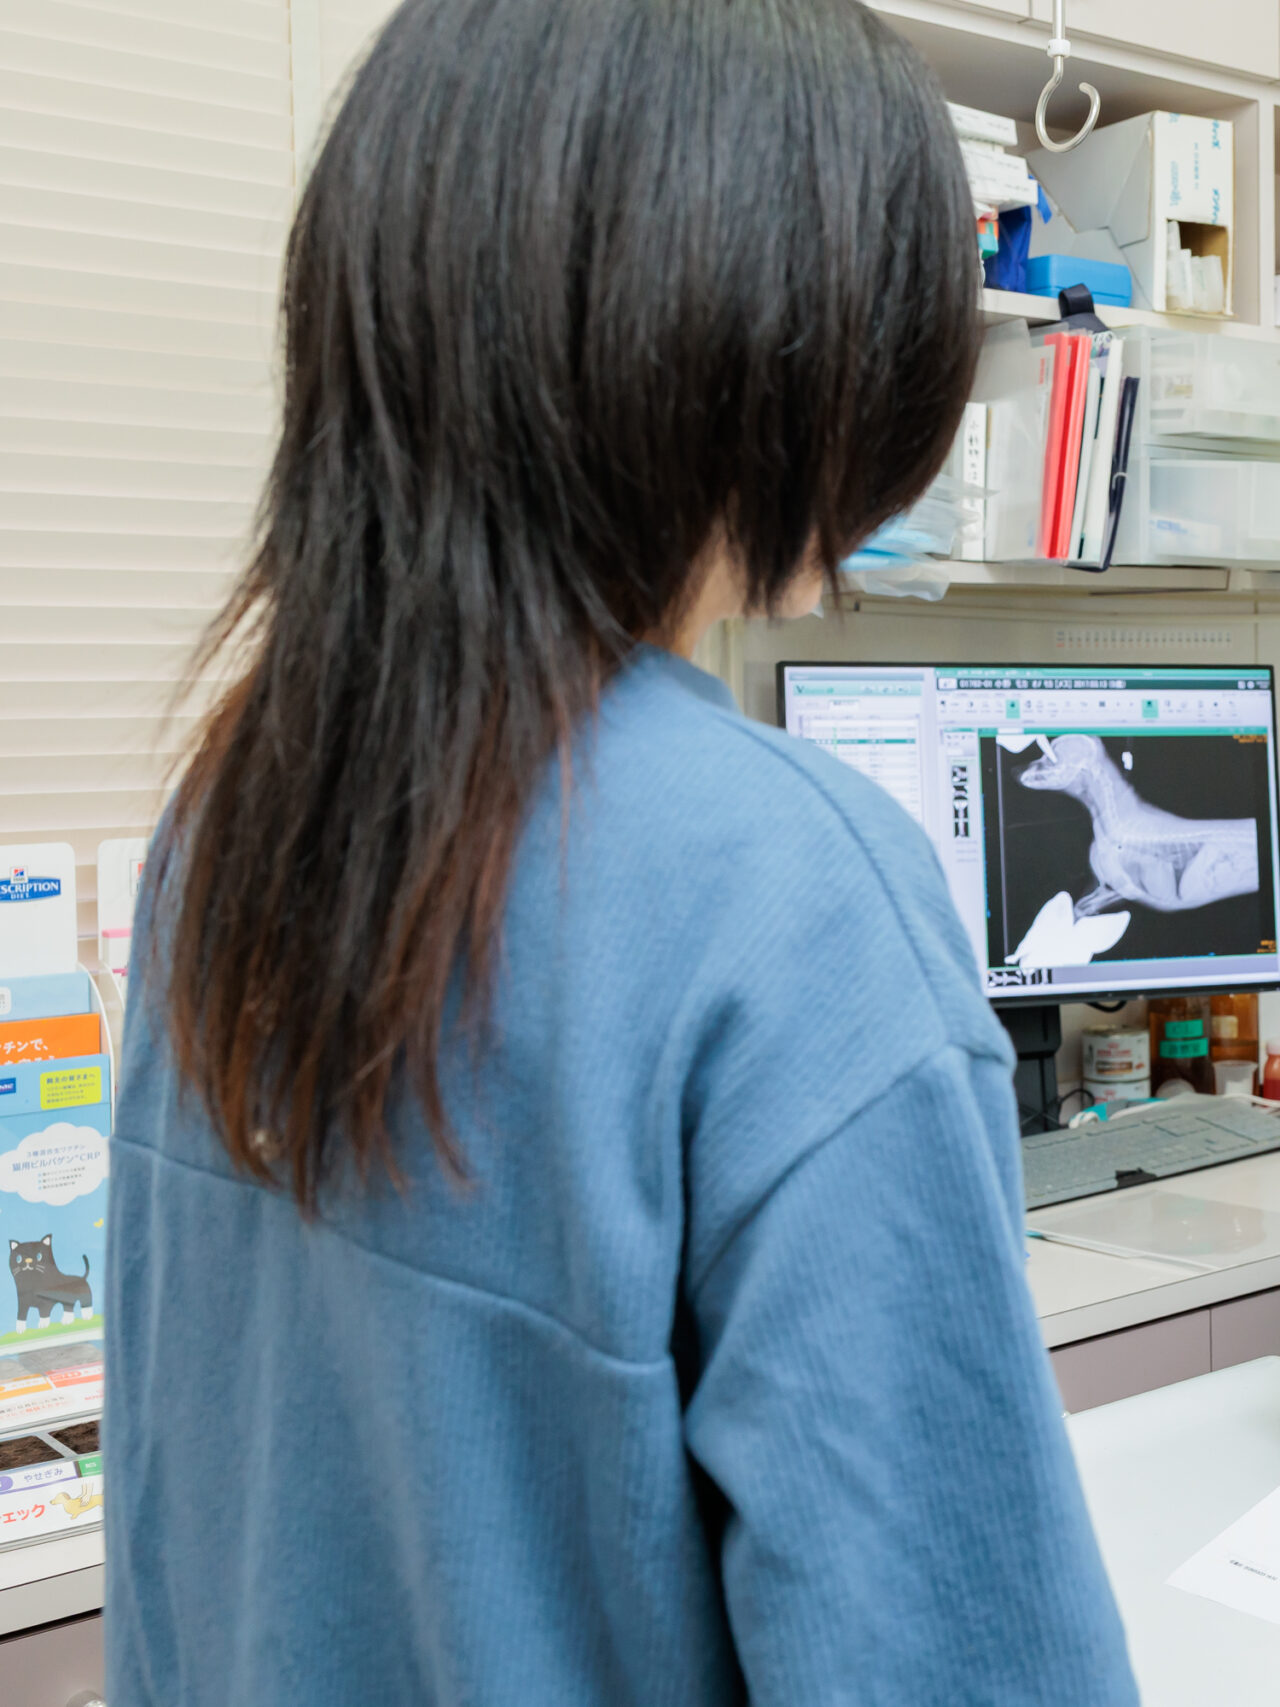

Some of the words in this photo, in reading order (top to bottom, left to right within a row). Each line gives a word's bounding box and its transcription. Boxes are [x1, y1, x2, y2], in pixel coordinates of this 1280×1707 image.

[0, 1038, 48, 1055] チンで、
[24, 1467, 64, 1482] やせぎみ
